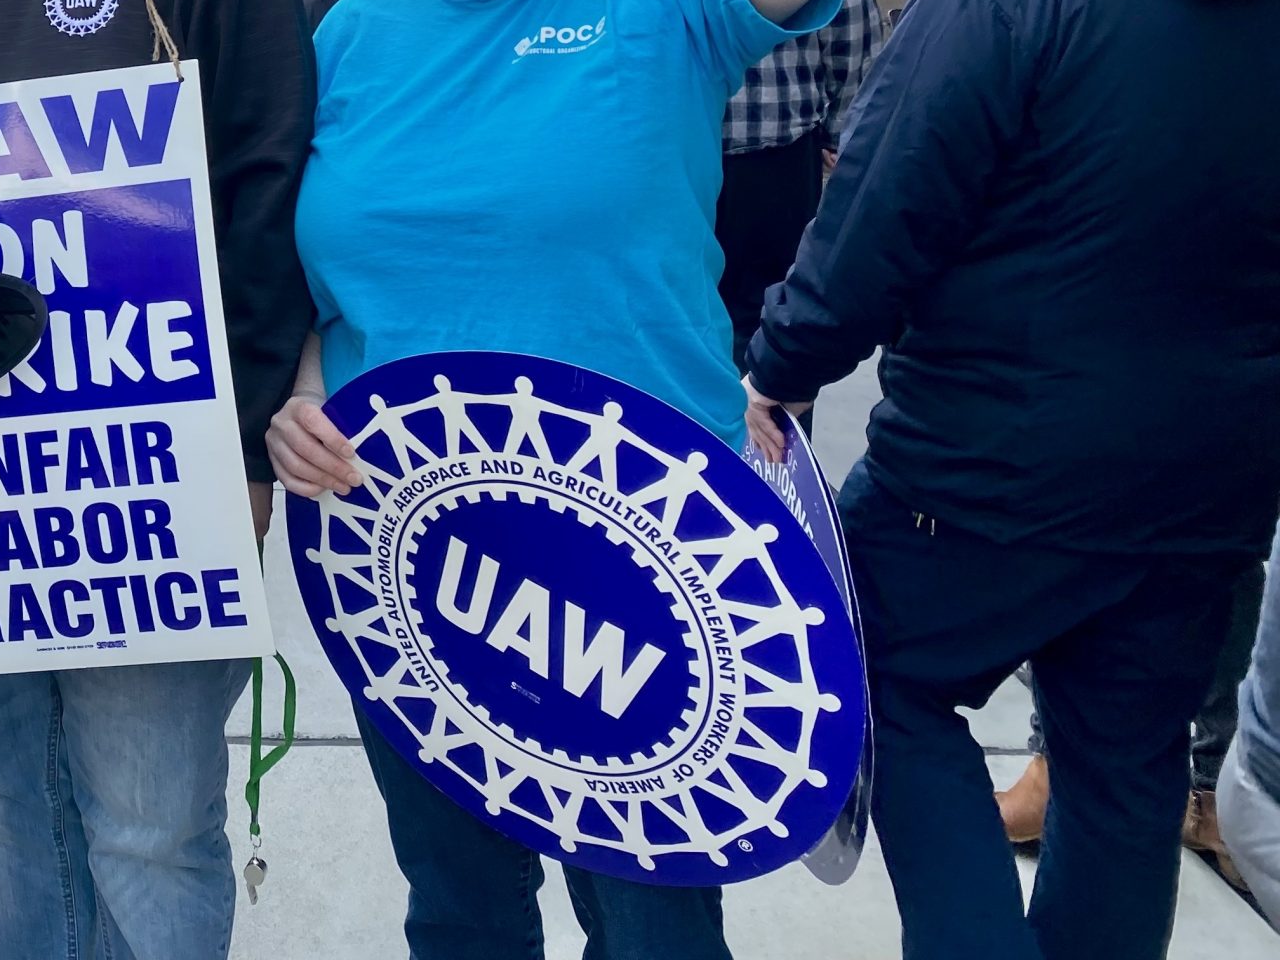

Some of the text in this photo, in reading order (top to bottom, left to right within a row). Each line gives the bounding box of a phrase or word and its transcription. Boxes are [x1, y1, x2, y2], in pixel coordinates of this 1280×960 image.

[377, 459, 737, 795] UNITED AUTOMOBILE, AEROSPACE AND AGRICULTURAL IMPLEMENT WORKERS OF AMERICA
[435, 535, 667, 720] UAW
